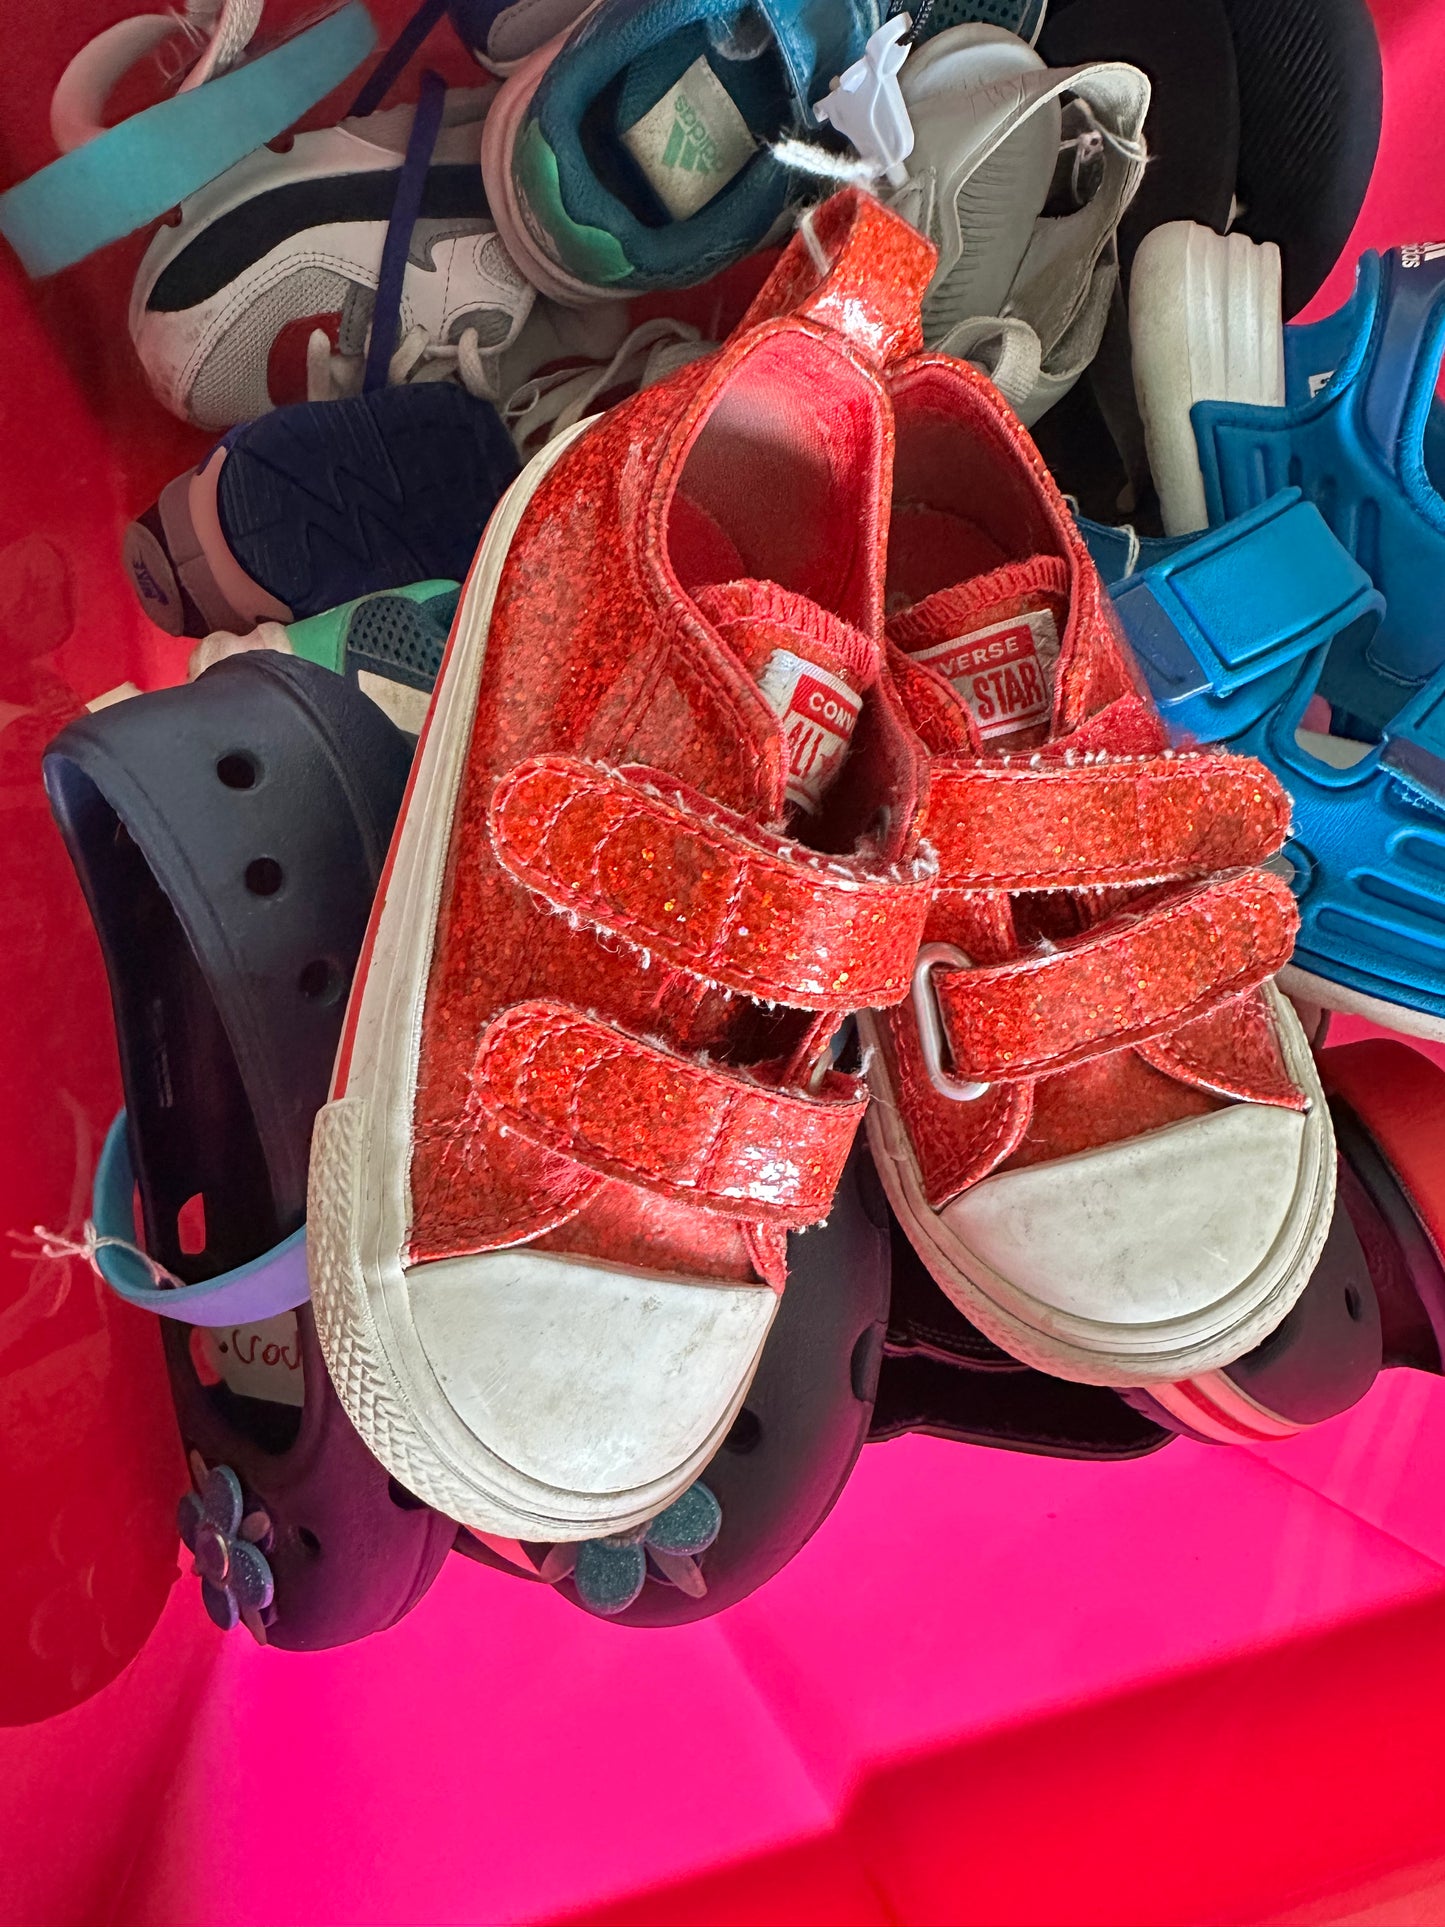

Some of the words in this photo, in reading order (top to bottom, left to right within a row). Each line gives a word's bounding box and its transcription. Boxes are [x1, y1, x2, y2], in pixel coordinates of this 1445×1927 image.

[674, 94, 723, 171] adidas
[940, 636, 1019, 675] VERSE
[973, 661, 1043, 720] STAR
